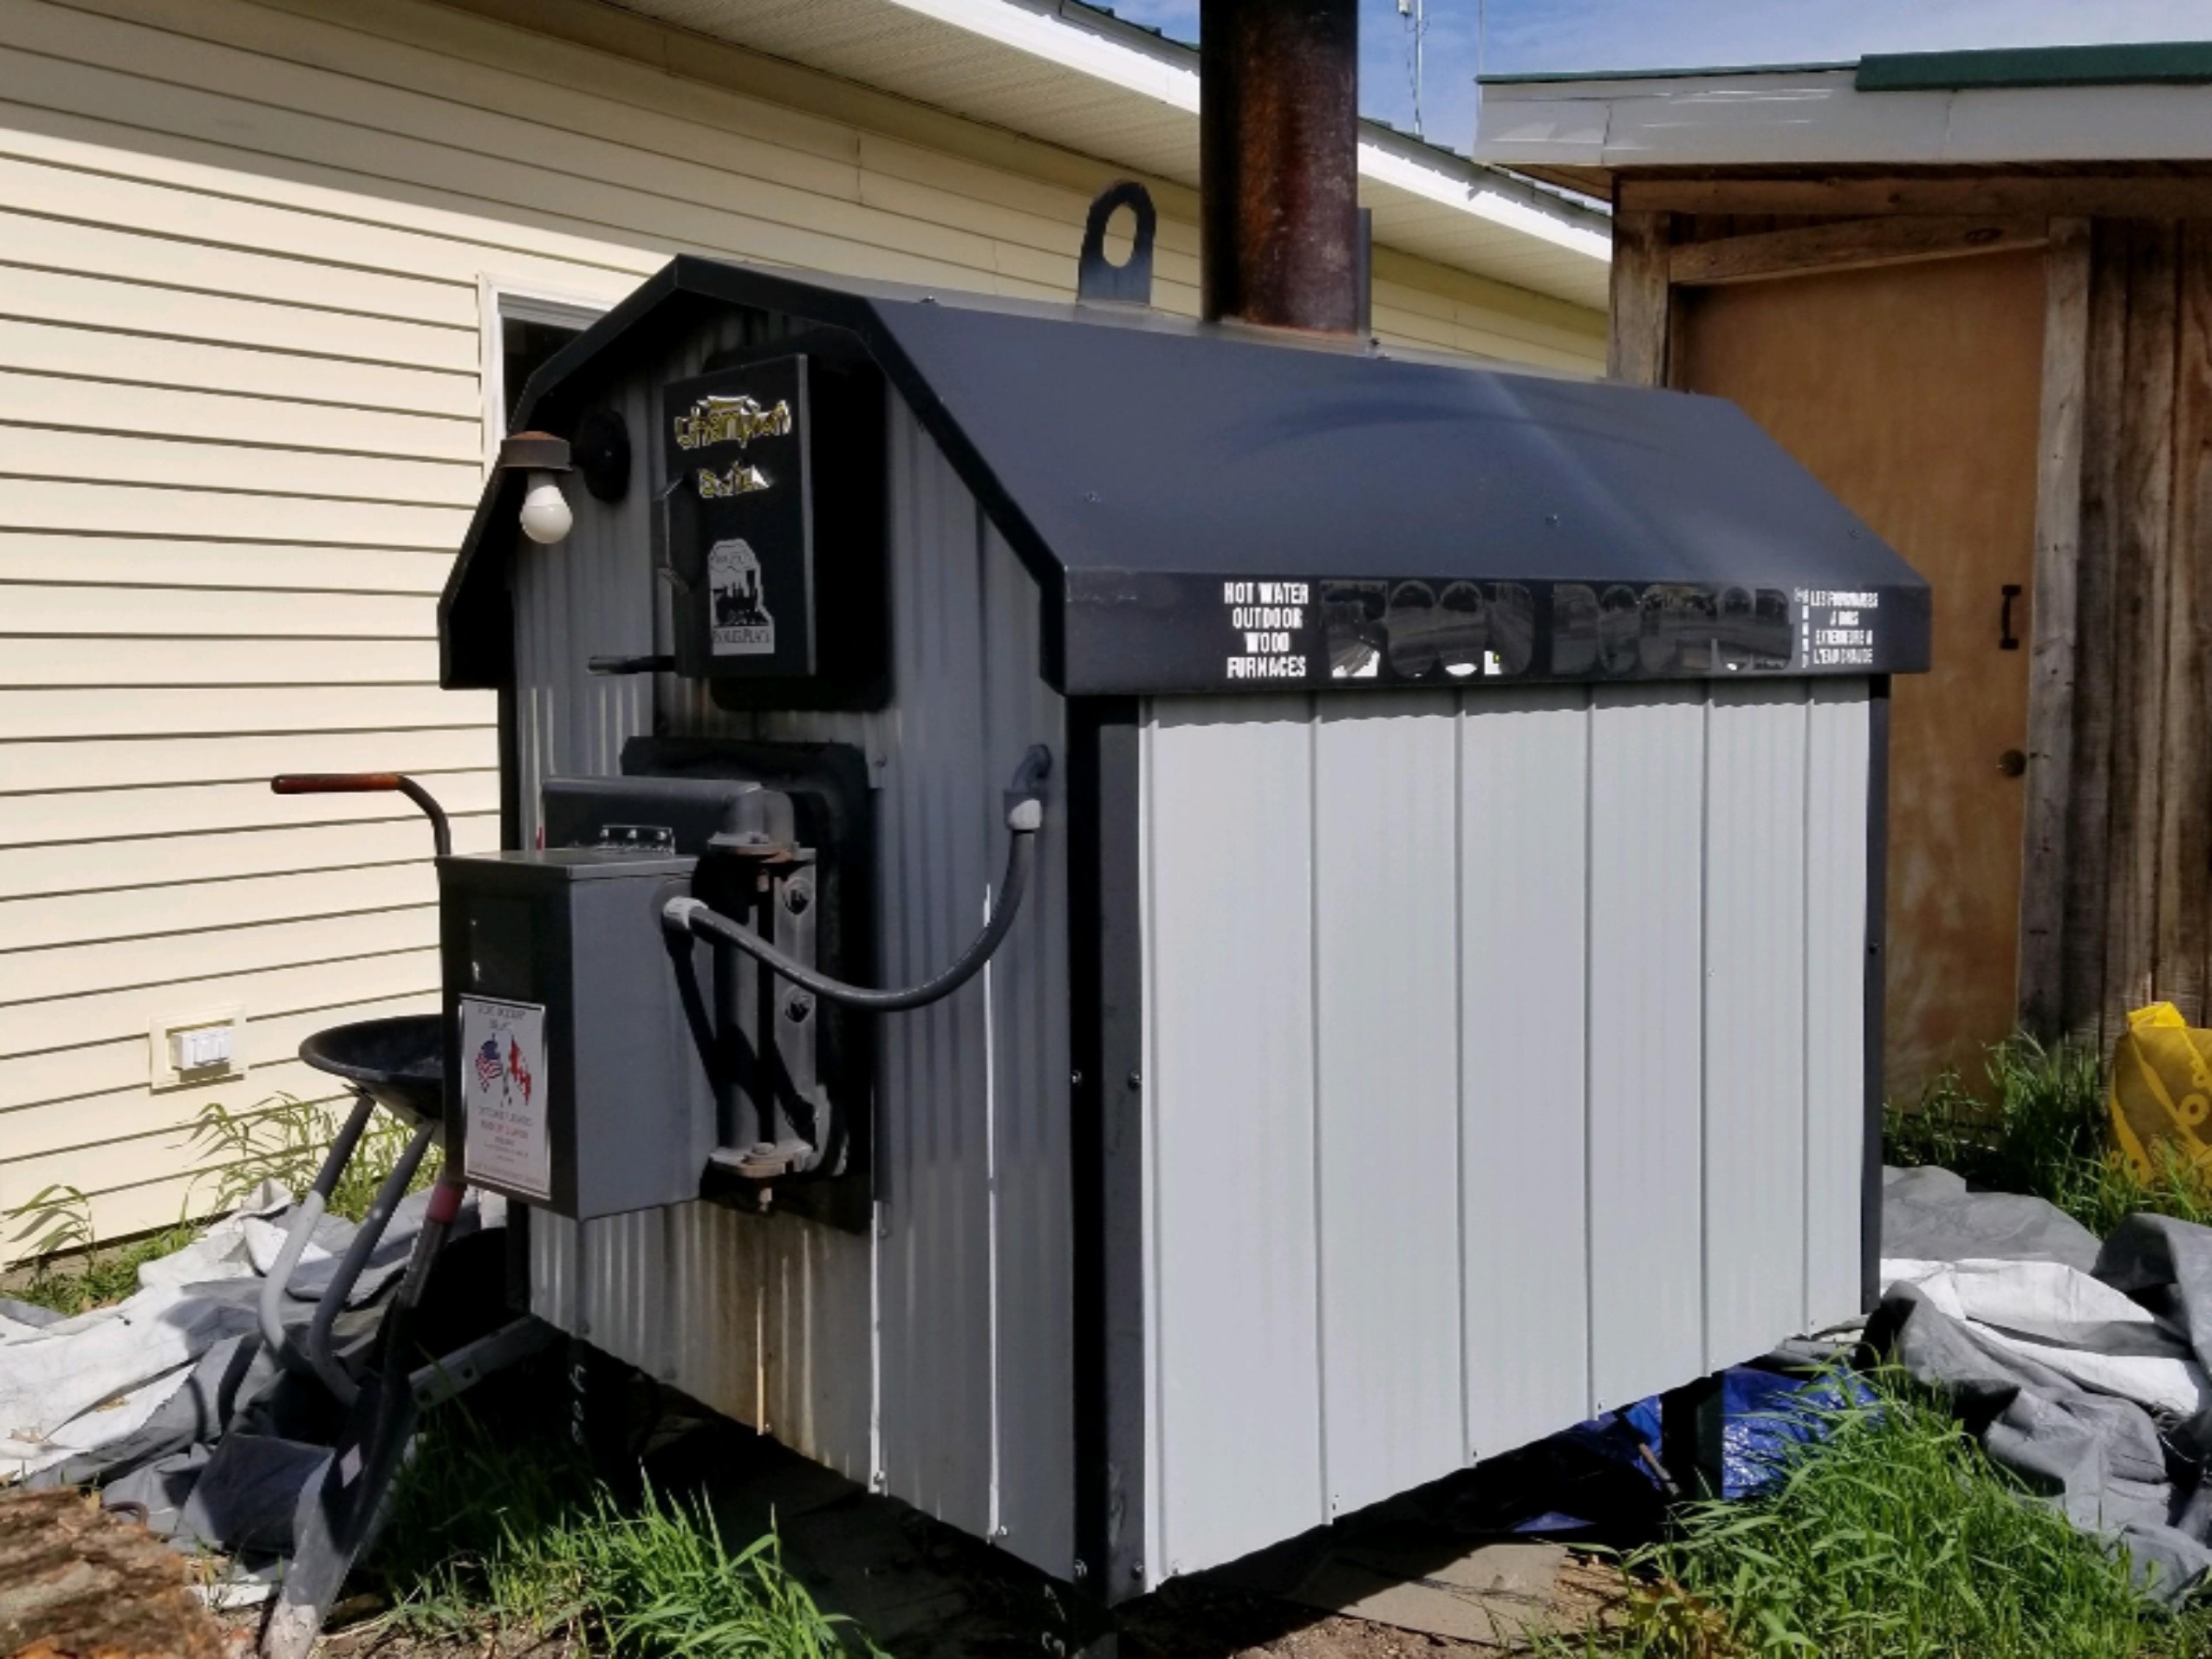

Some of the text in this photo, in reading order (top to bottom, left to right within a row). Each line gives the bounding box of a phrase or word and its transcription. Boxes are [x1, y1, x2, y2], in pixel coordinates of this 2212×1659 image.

[1224, 582, 1309, 604] HOT WATER
[1232, 607, 1304, 629] OUTDOOR
[1243, 631, 1291, 654] WOOD
[1226, 654, 1307, 679] FURNACES
